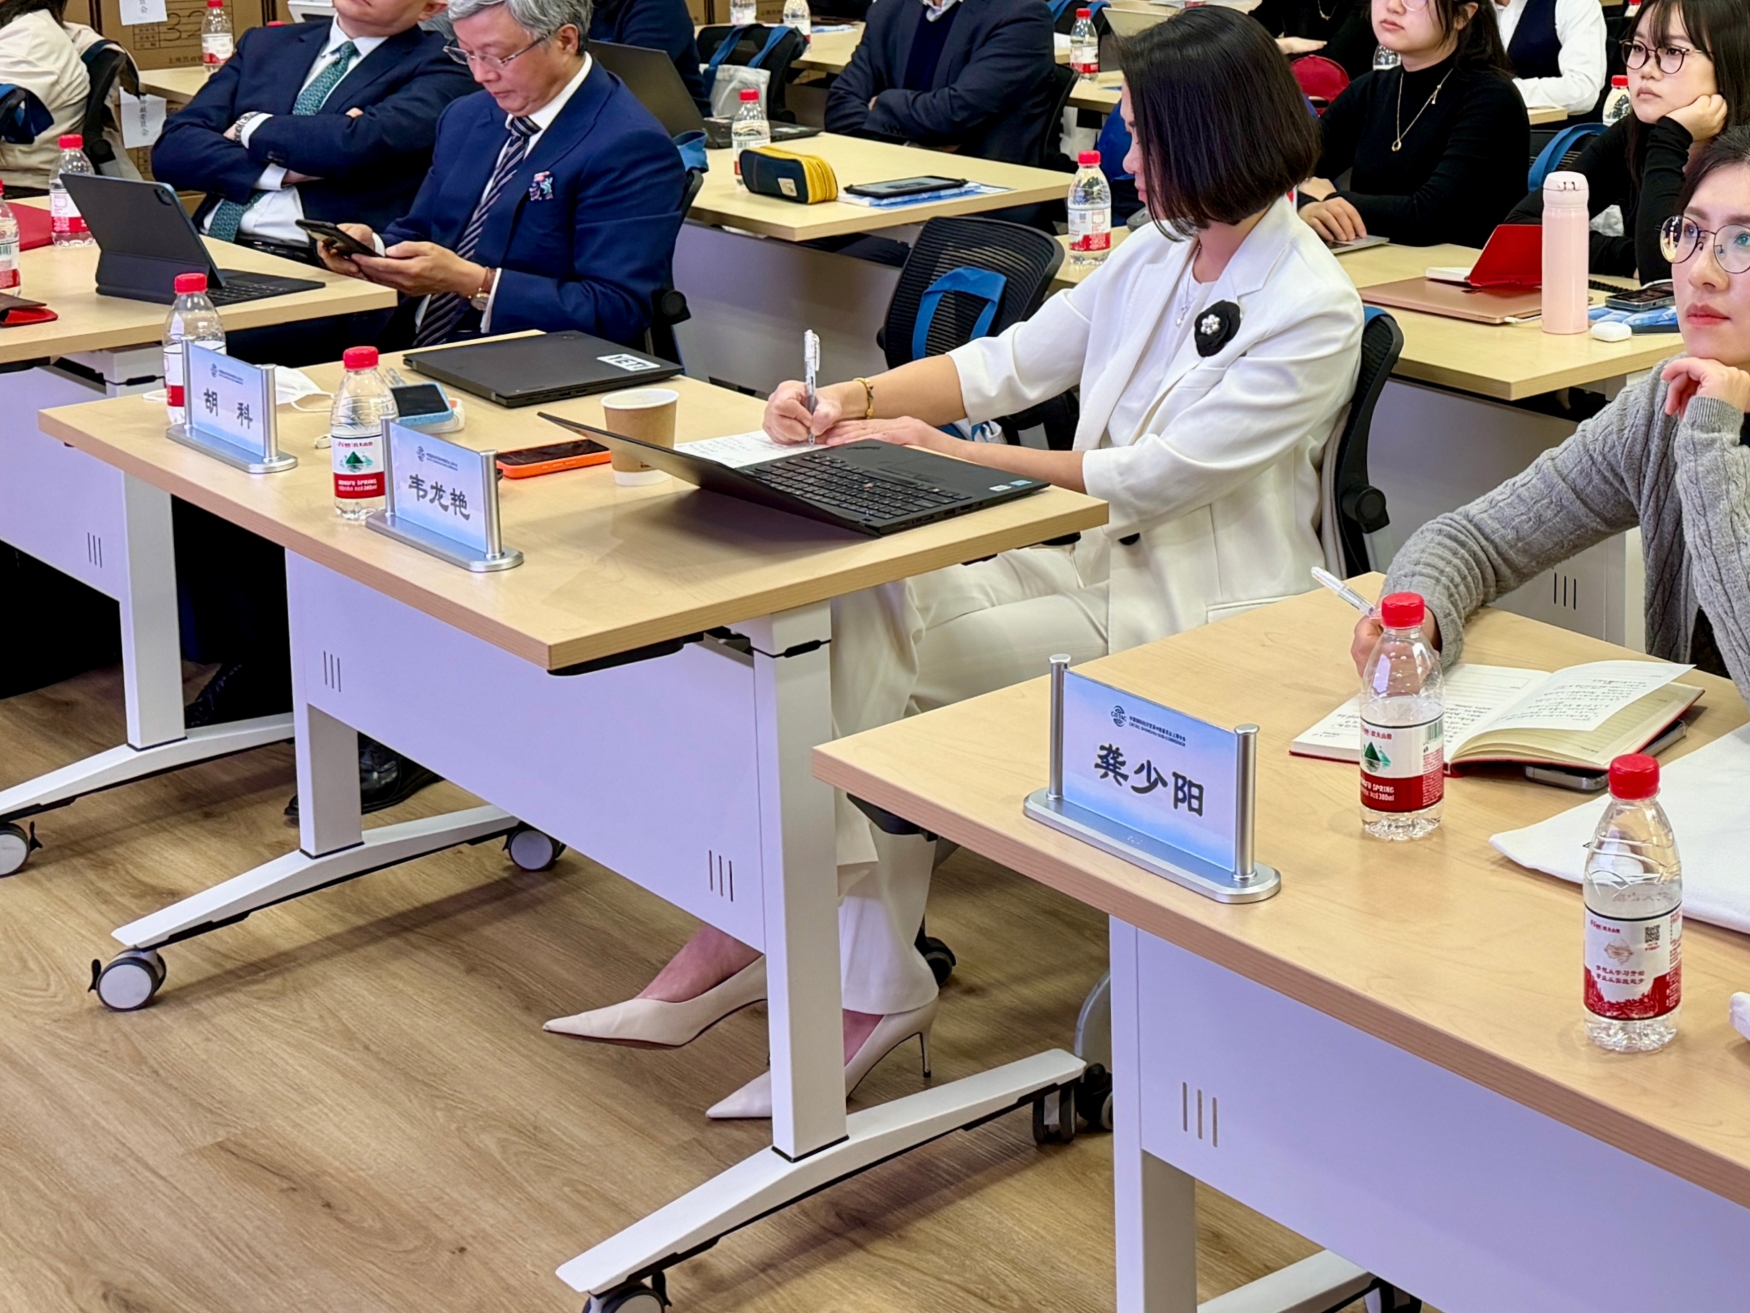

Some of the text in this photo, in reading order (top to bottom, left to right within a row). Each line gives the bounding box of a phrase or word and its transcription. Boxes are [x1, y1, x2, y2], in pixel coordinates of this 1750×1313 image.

[165, 9, 206, 42] 32
[408, 473, 471, 521] 韦龙艳
[1094, 743, 1204, 817] 龚少阳
